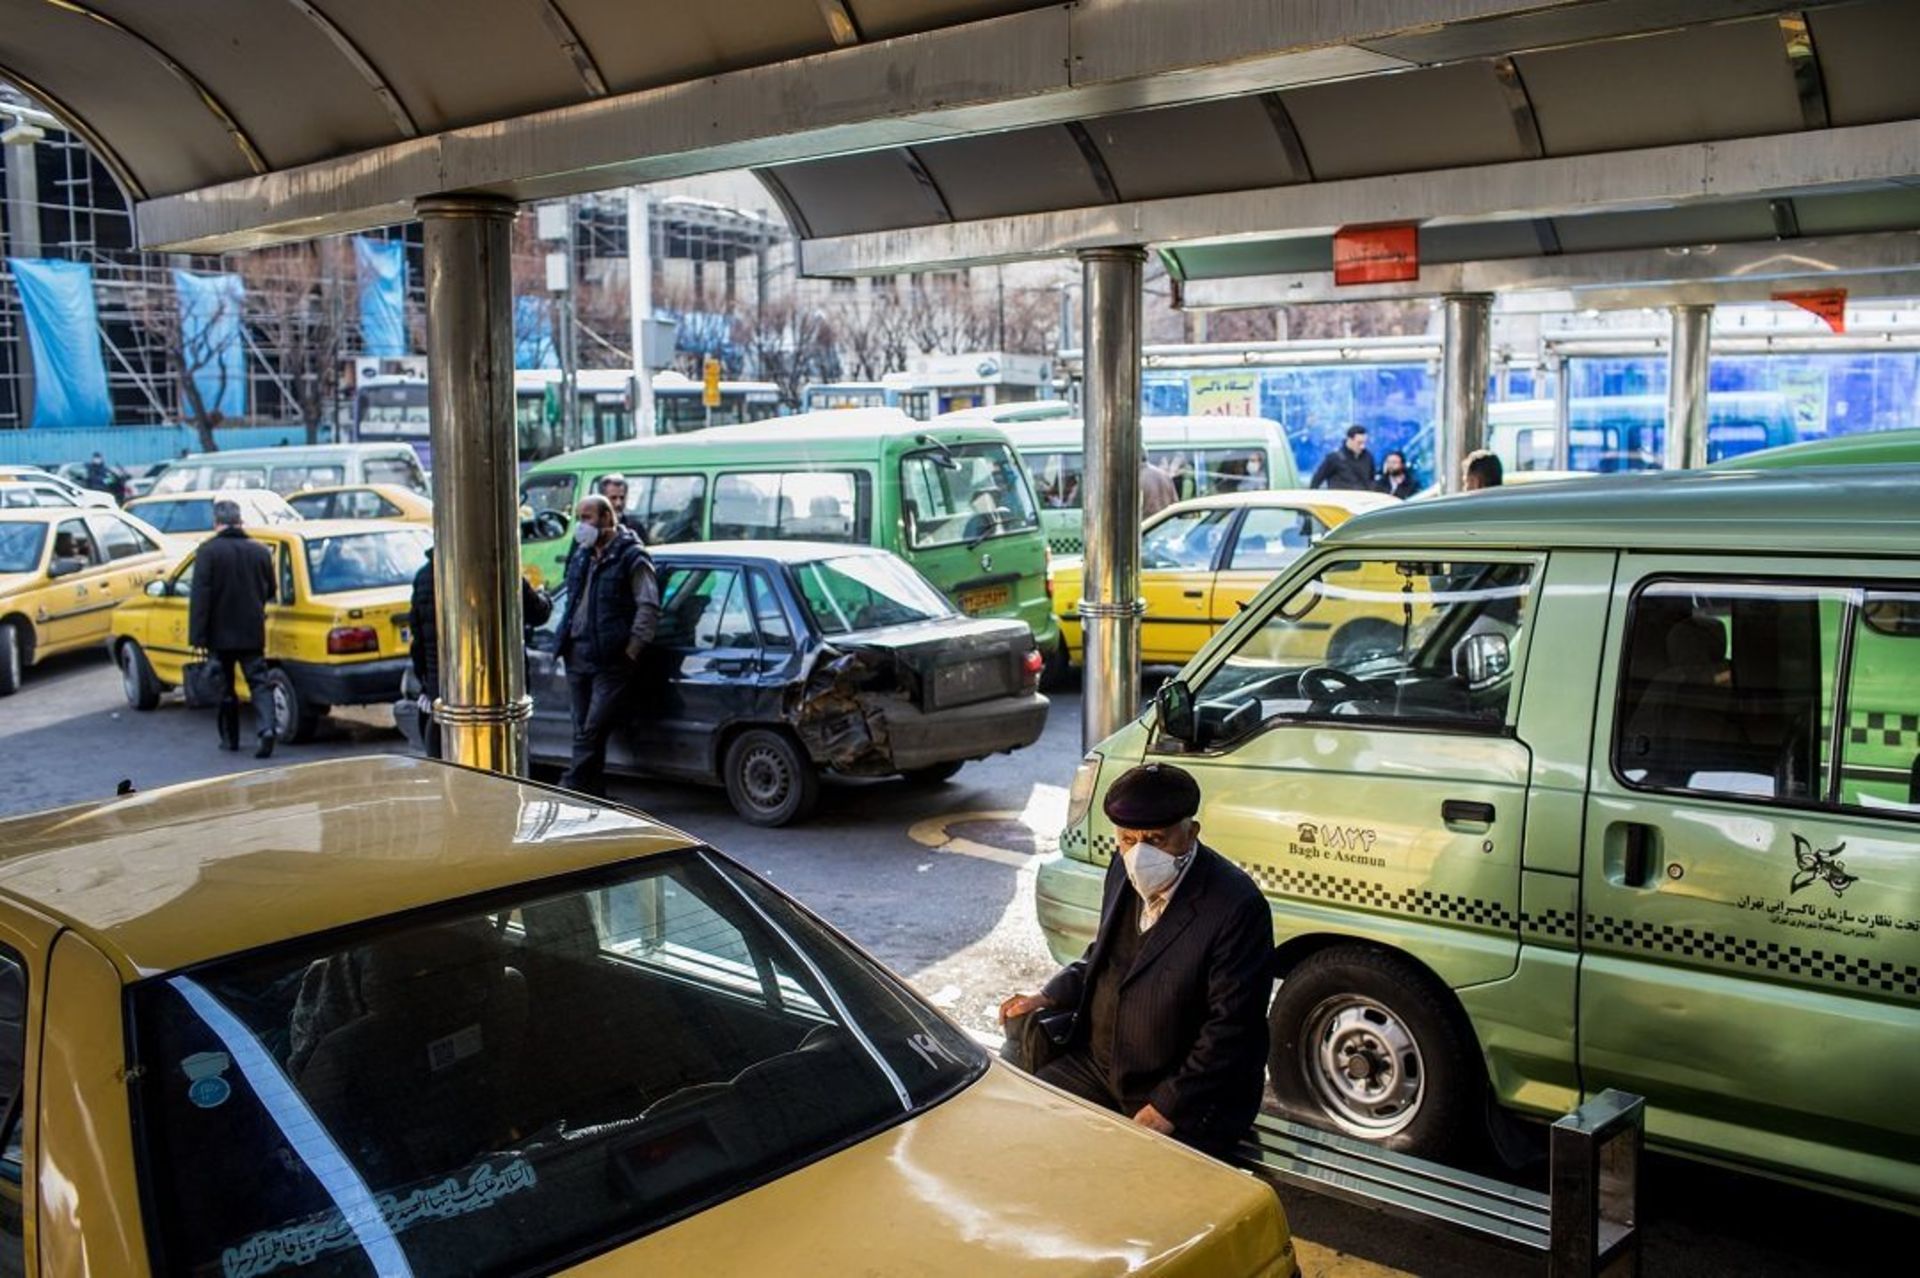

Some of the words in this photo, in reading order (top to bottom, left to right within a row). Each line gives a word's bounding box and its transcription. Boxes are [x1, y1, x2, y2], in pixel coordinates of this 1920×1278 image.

[1289, 842, 1320, 860] Bagh
[1333, 851, 1386, 867] Asemun
[1737, 895, 1765, 911] تهران
